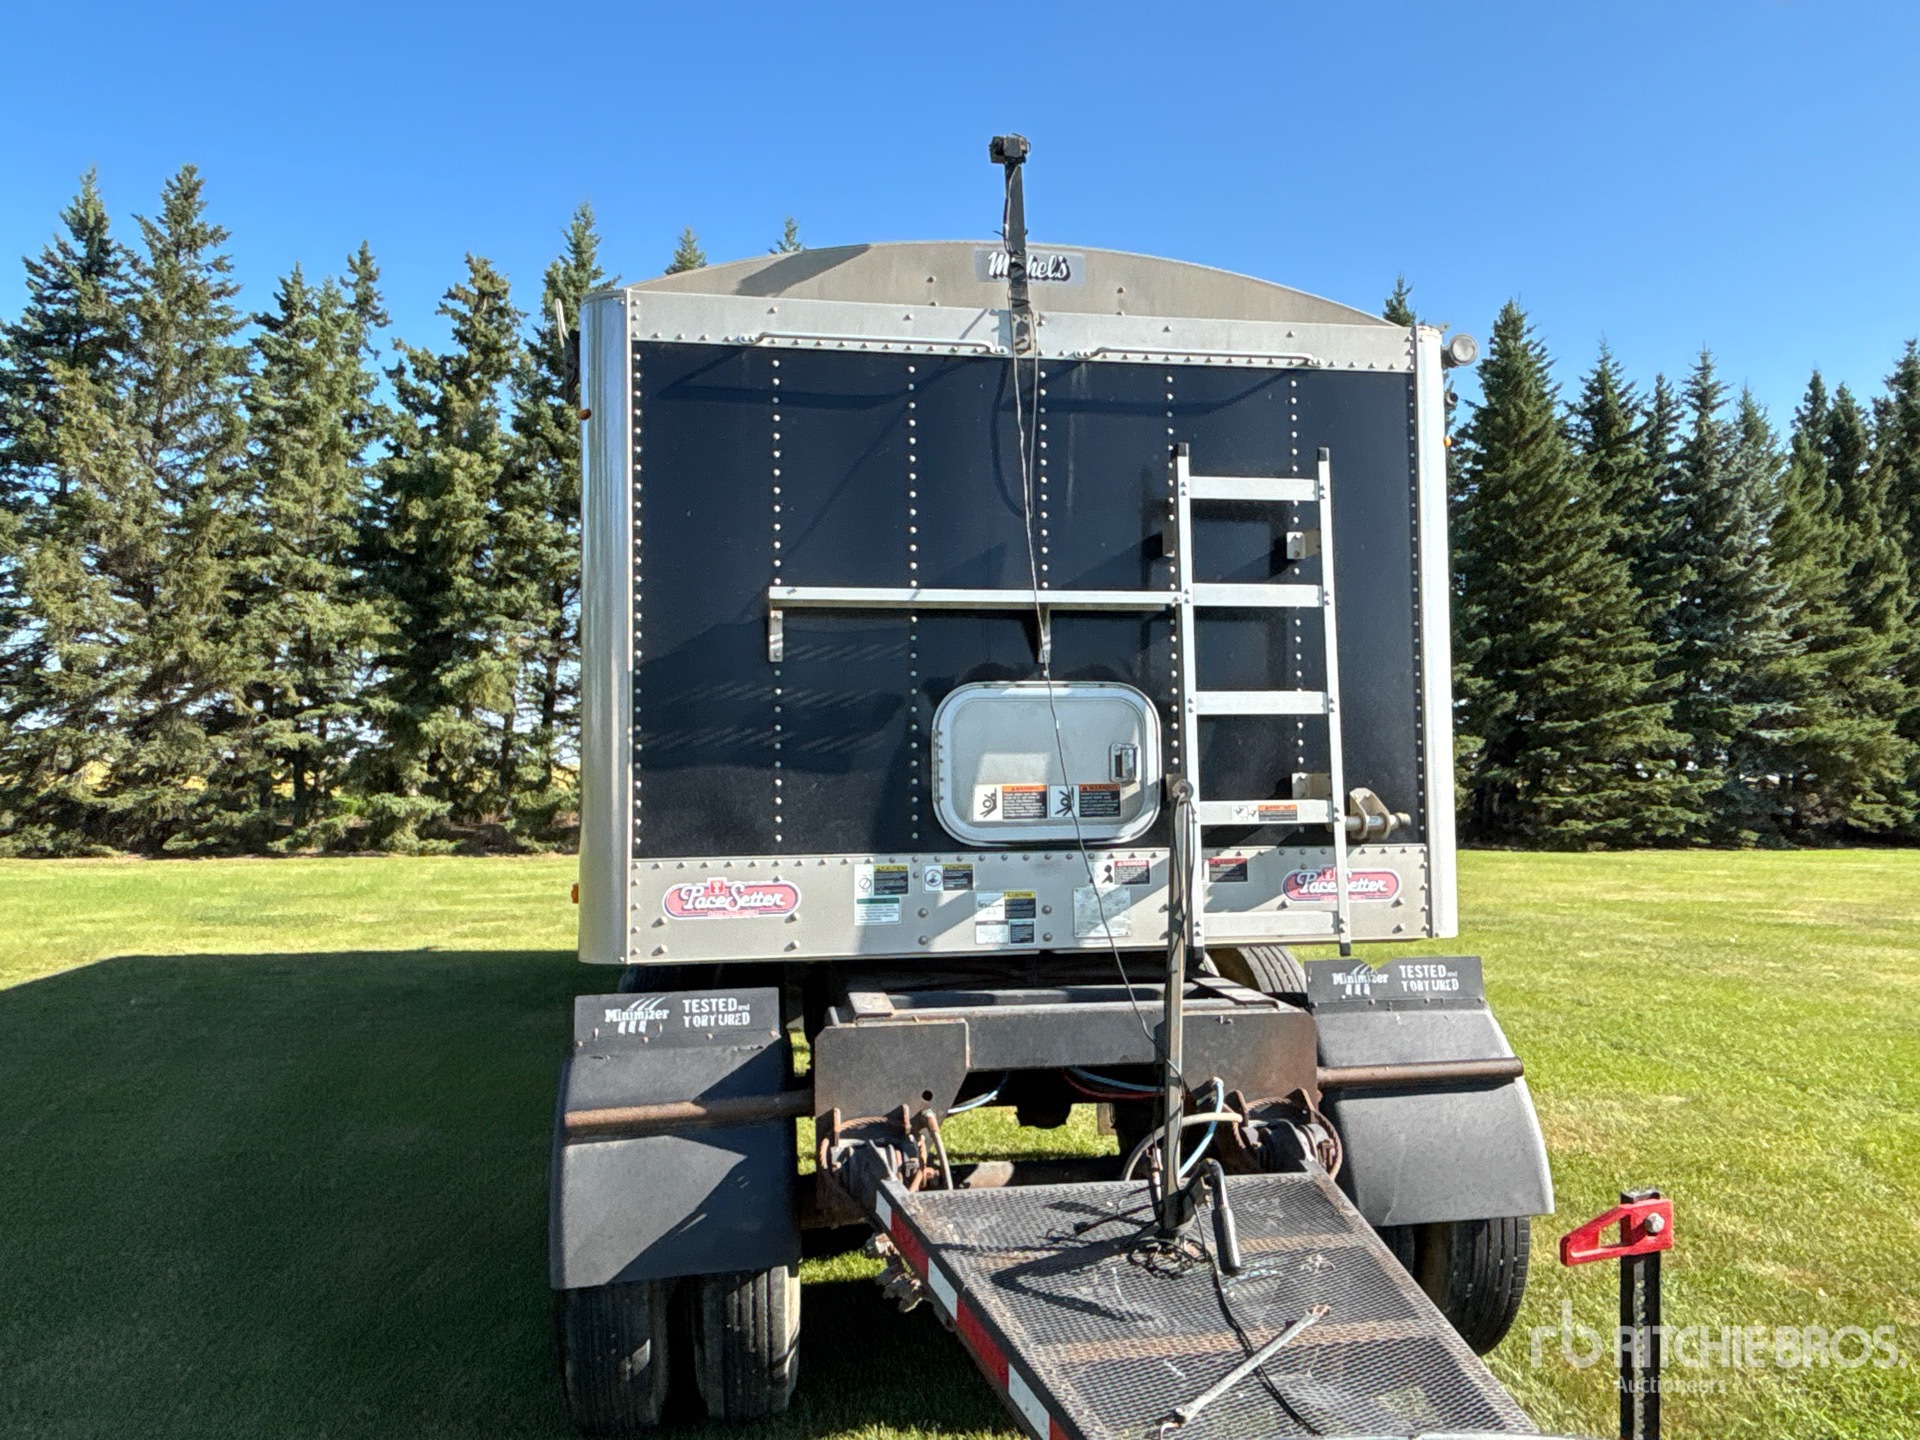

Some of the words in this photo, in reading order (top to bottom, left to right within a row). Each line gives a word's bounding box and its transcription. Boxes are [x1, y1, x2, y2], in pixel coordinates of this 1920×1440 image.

[988, 251, 1069, 280] Mhel's
[1332, 972, 1389, 985] Minimizer
[1399, 964, 1446, 979] TESTED
[1401, 978, 1459, 992] TORTURED
[682, 997, 737, 1013] TESTED
[604, 1008, 669, 1022] Minimizer
[682, 1011, 750, 1028] TORTURED
